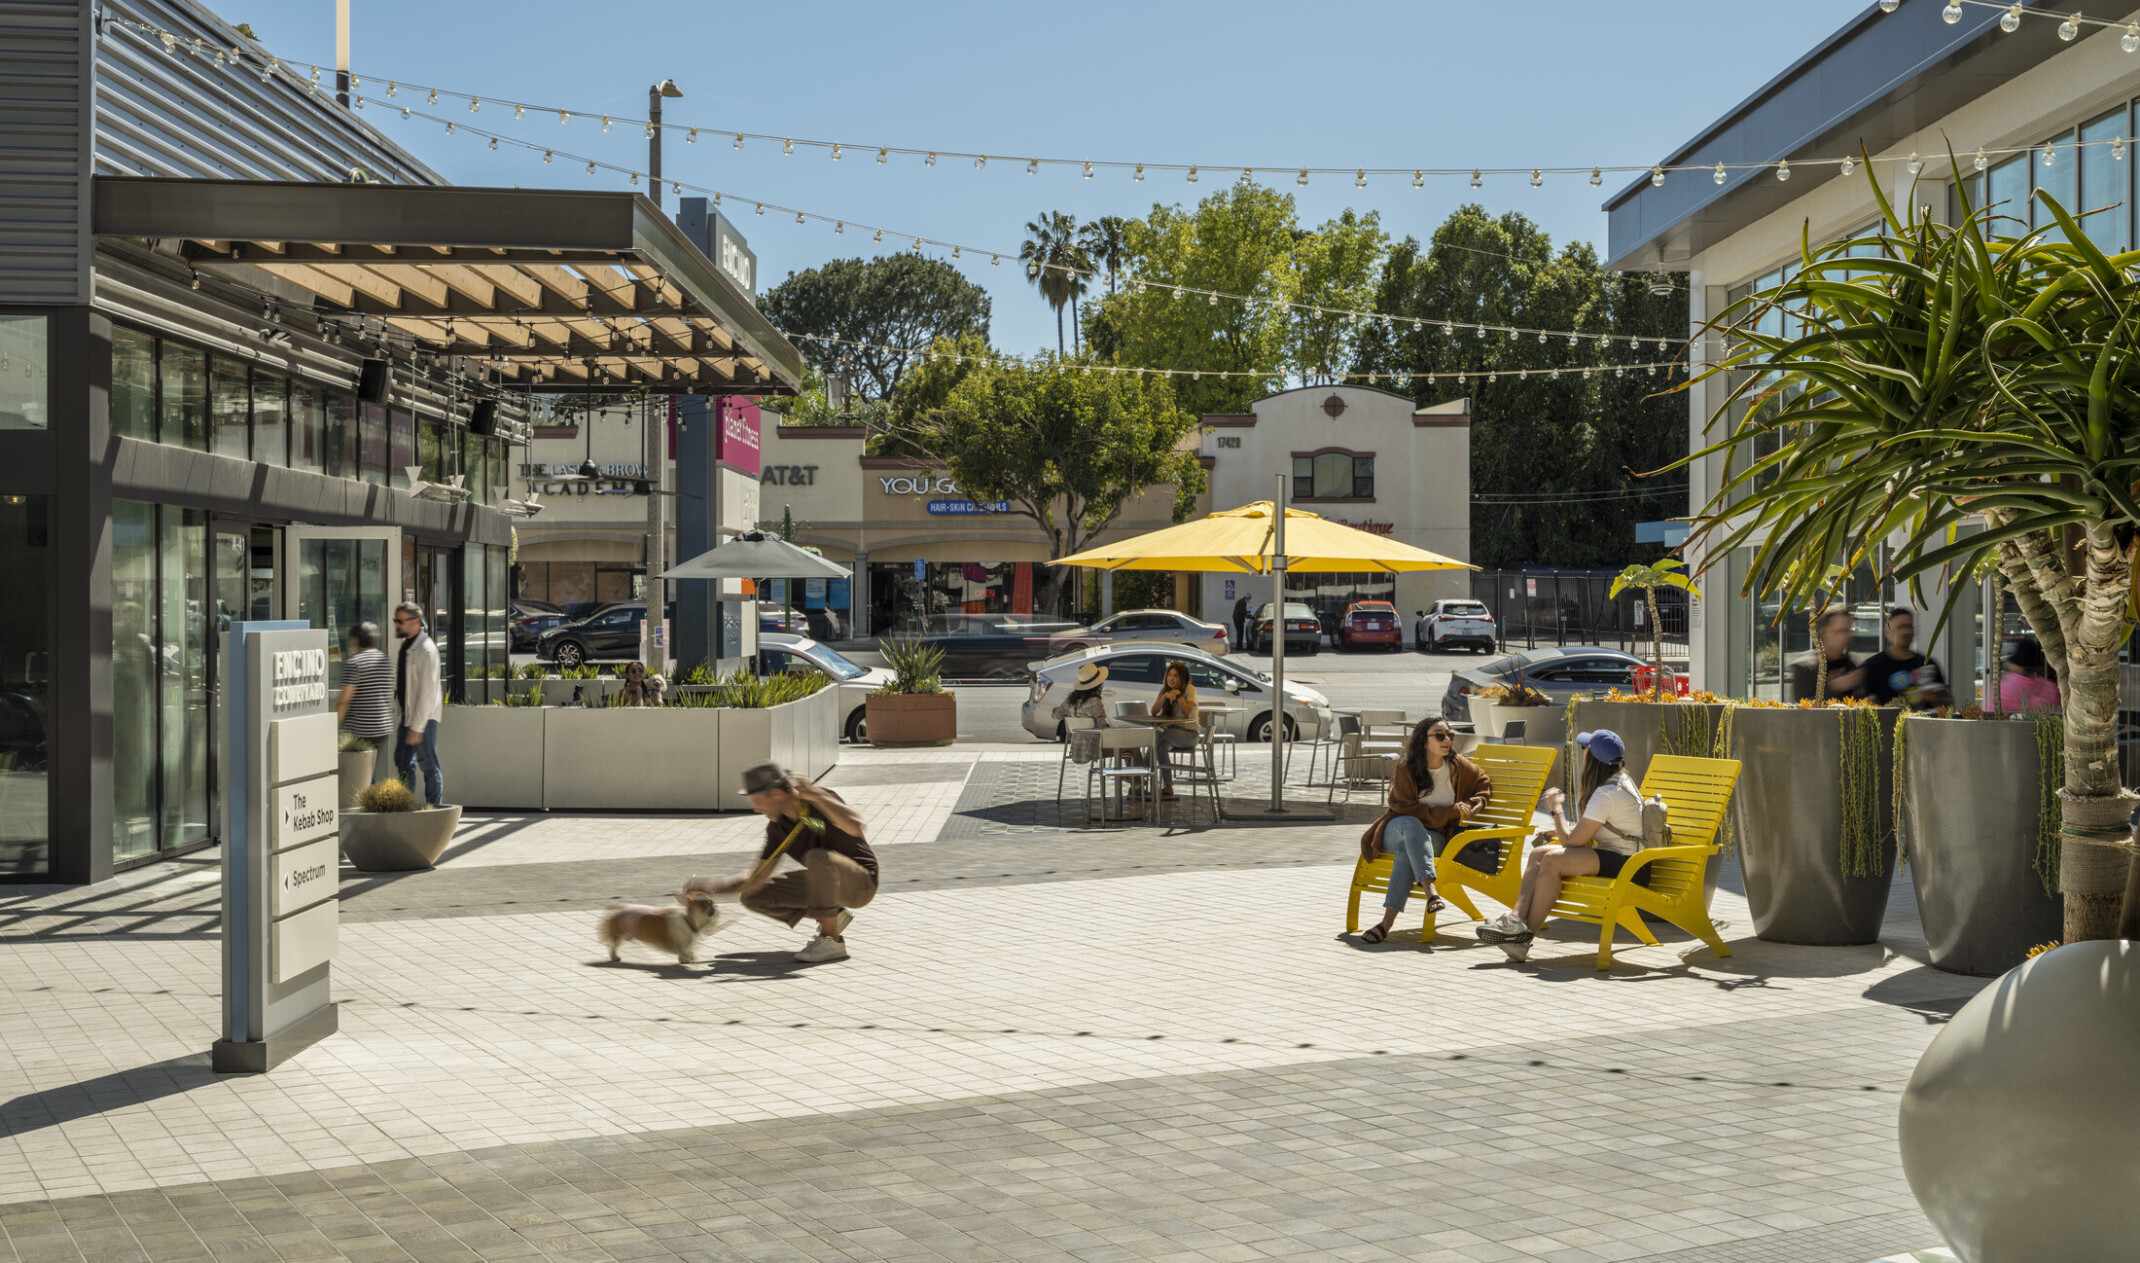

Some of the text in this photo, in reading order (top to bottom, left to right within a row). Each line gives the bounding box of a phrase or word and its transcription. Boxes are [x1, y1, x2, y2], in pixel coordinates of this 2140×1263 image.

[760, 465, 819, 486] AT&T
[879, 477, 929, 494] YOU
[930, 502, 966, 512] HAIR-SKIN
[974, 589, 996, 598] OPEN
[273, 649, 325, 680] ENCINO
[293, 793, 306, 810] The
[293, 808, 334, 832] Kebab Shop
[293, 864, 326, 888] Spectrum
